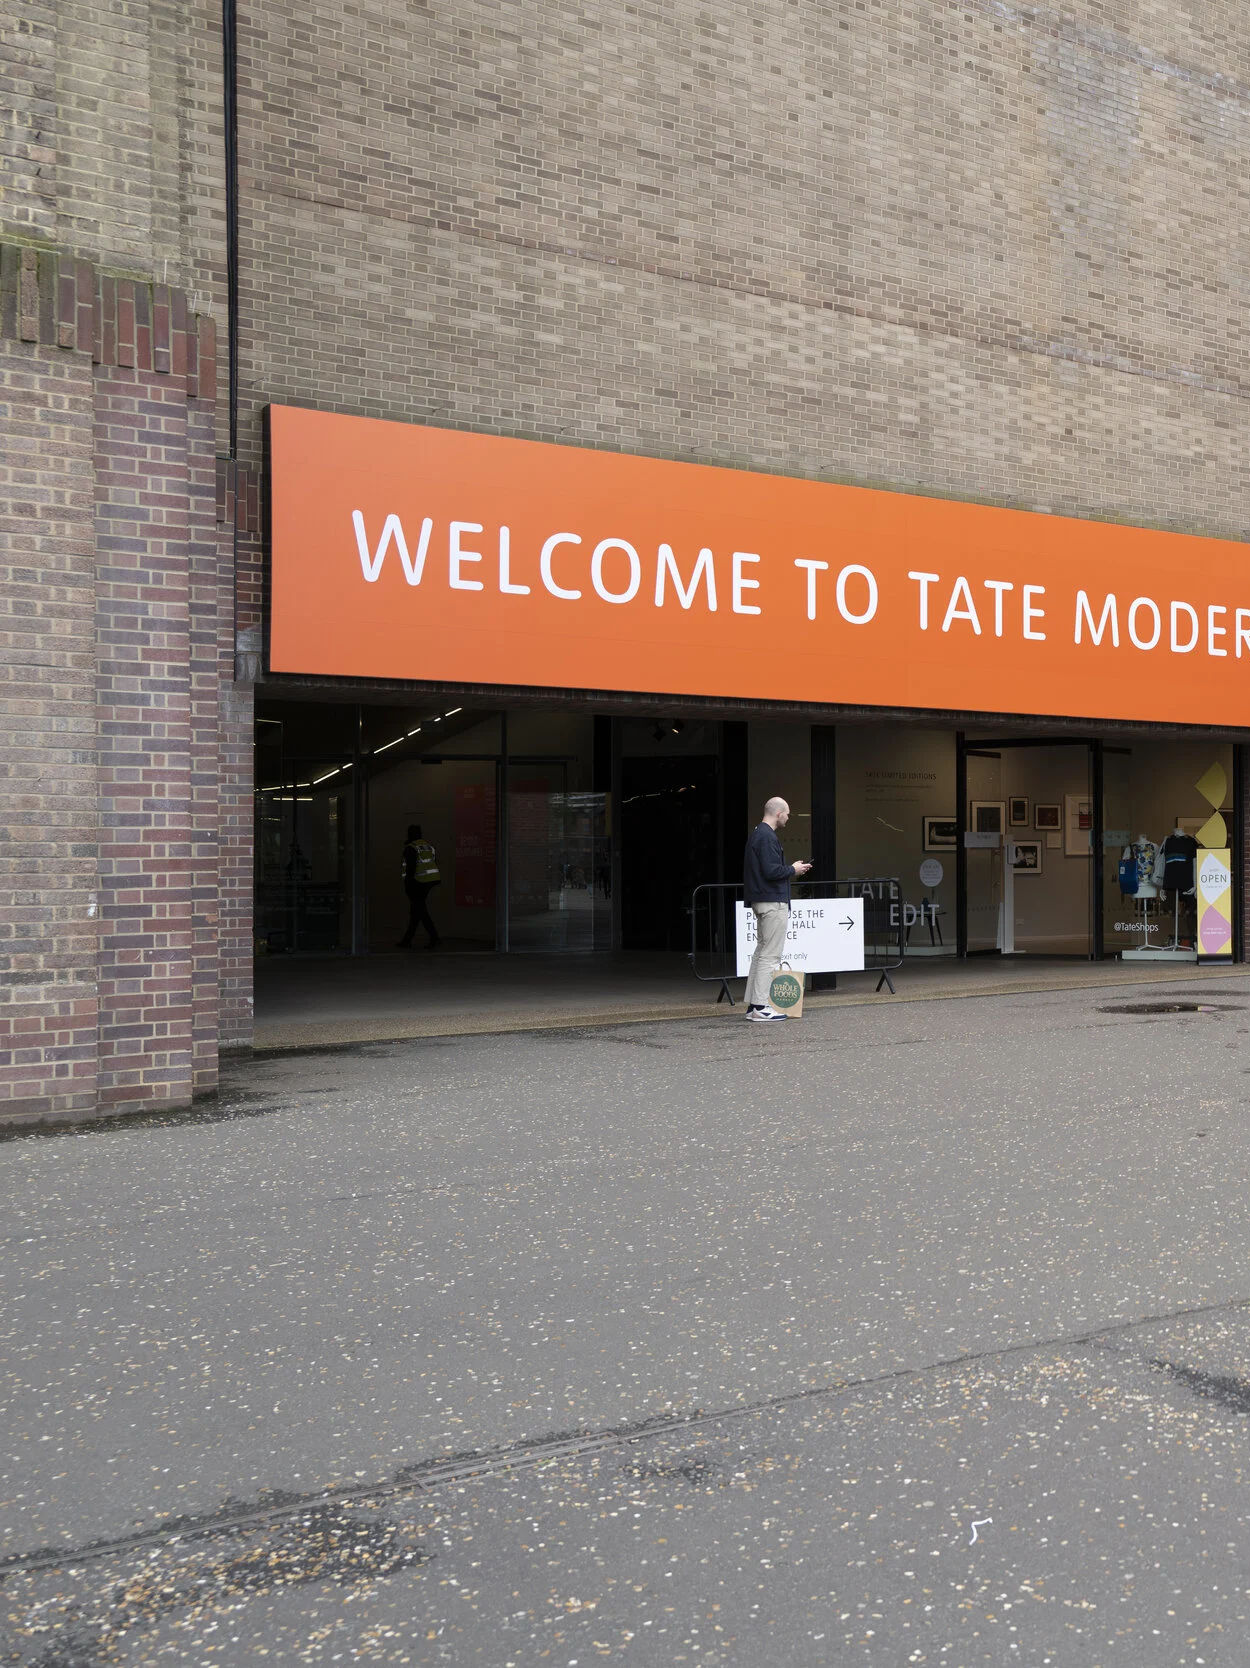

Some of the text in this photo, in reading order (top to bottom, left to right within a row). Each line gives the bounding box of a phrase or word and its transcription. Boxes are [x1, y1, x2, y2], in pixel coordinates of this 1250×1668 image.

[351, 509, 762, 616] WELCOME
[794, 558, 879, 625] TO
[907, 570, 1047, 641] TATE
[908, 772, 937, 782] EDITIONS
[1200, 874, 1227, 884] OPEN
[847, 877, 900, 900] TATE
[806, 909, 824, 919] THE
[889, 903, 940, 927] EDIT
[792, 920, 816, 930] HALL
[1113, 922, 1159, 933] @TateShops
[746, 931, 798, 942] ENCE
[793, 951, 808, 961] only
[773, 983, 798, 992] WHOLE
[773, 991, 797, 999] FOODS
